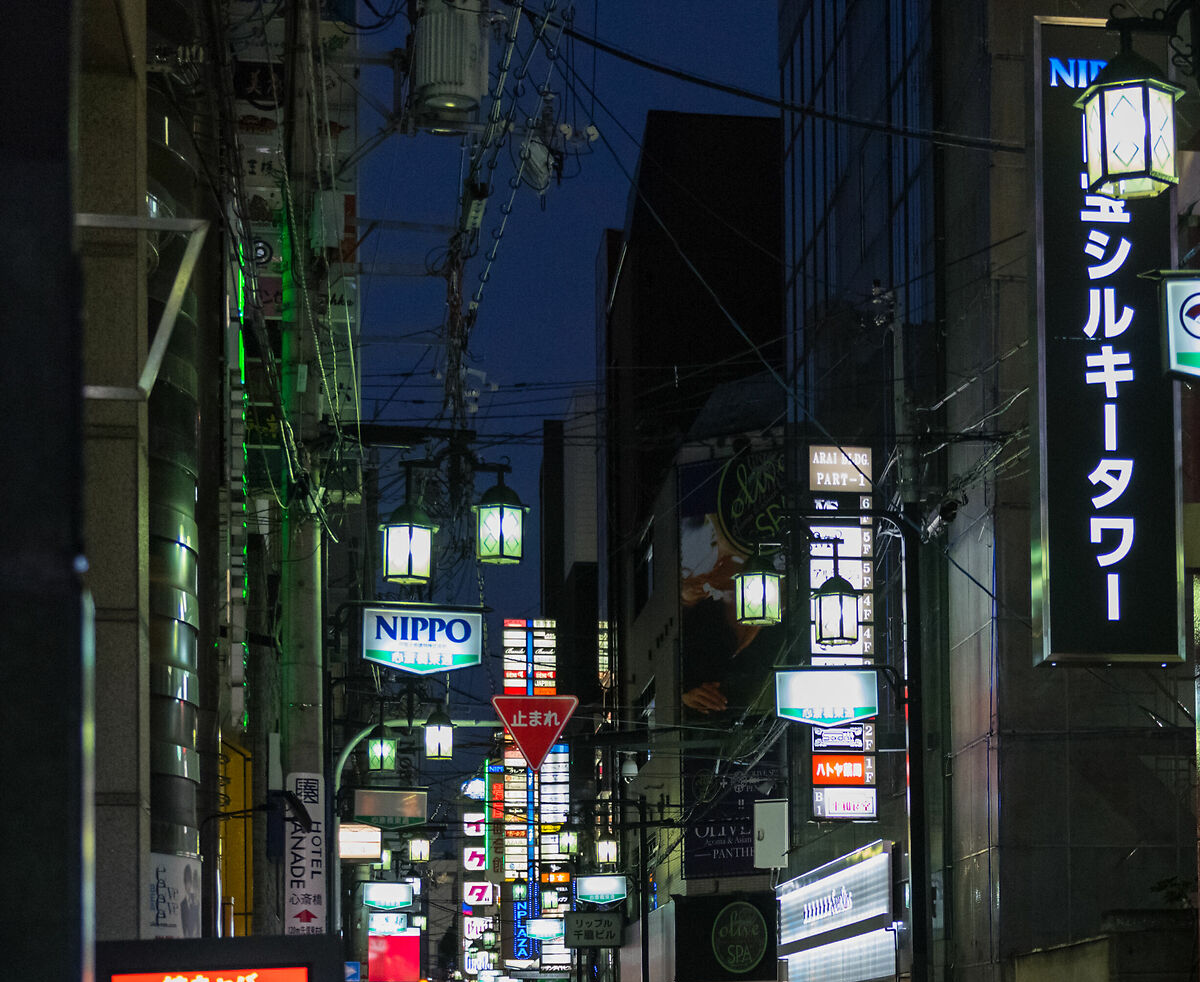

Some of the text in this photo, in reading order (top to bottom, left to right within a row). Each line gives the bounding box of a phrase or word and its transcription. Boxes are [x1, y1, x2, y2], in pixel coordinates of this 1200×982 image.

[812, 451, 837, 465] ARAI
[816, 471, 866, 487] PART-1
[375, 615, 472, 643] NIPPO
[511, 710, 560, 727] 止まれ
[290, 820, 305, 889] ANADE
[311, 821, 322, 880] HOTEL
